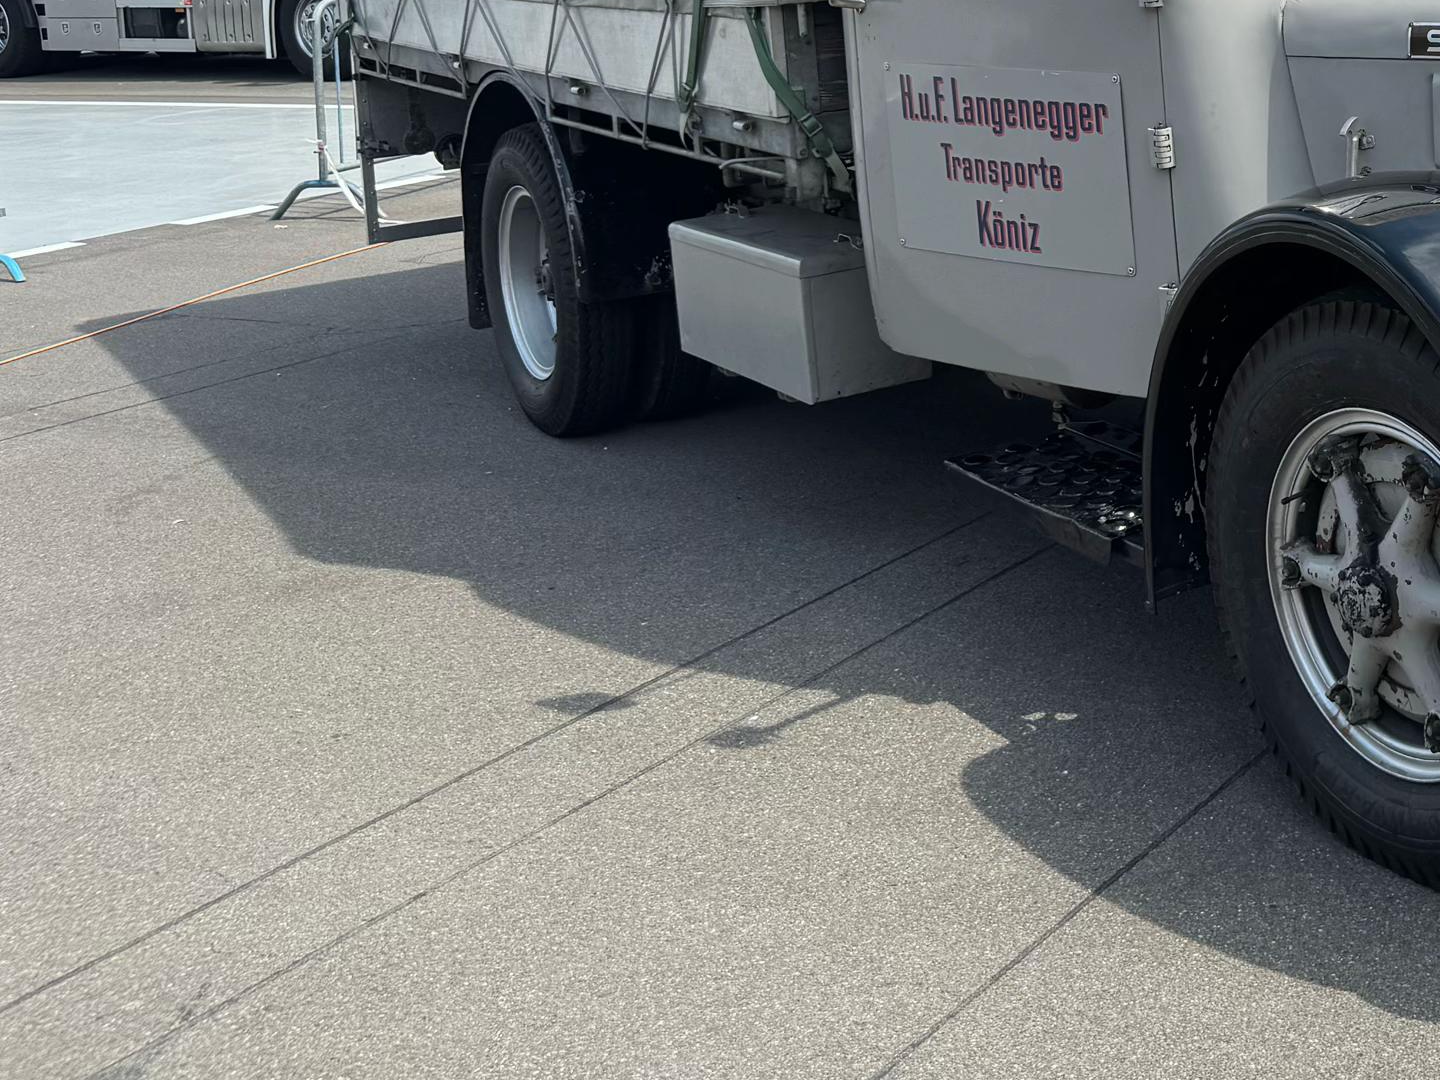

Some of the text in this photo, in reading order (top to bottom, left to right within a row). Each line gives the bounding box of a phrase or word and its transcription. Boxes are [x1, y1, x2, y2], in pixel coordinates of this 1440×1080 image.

[950, 77, 1109, 142] Langenegger
[940, 142, 1064, 193] Transporte
[976, 199, 1042, 254] Köniz
